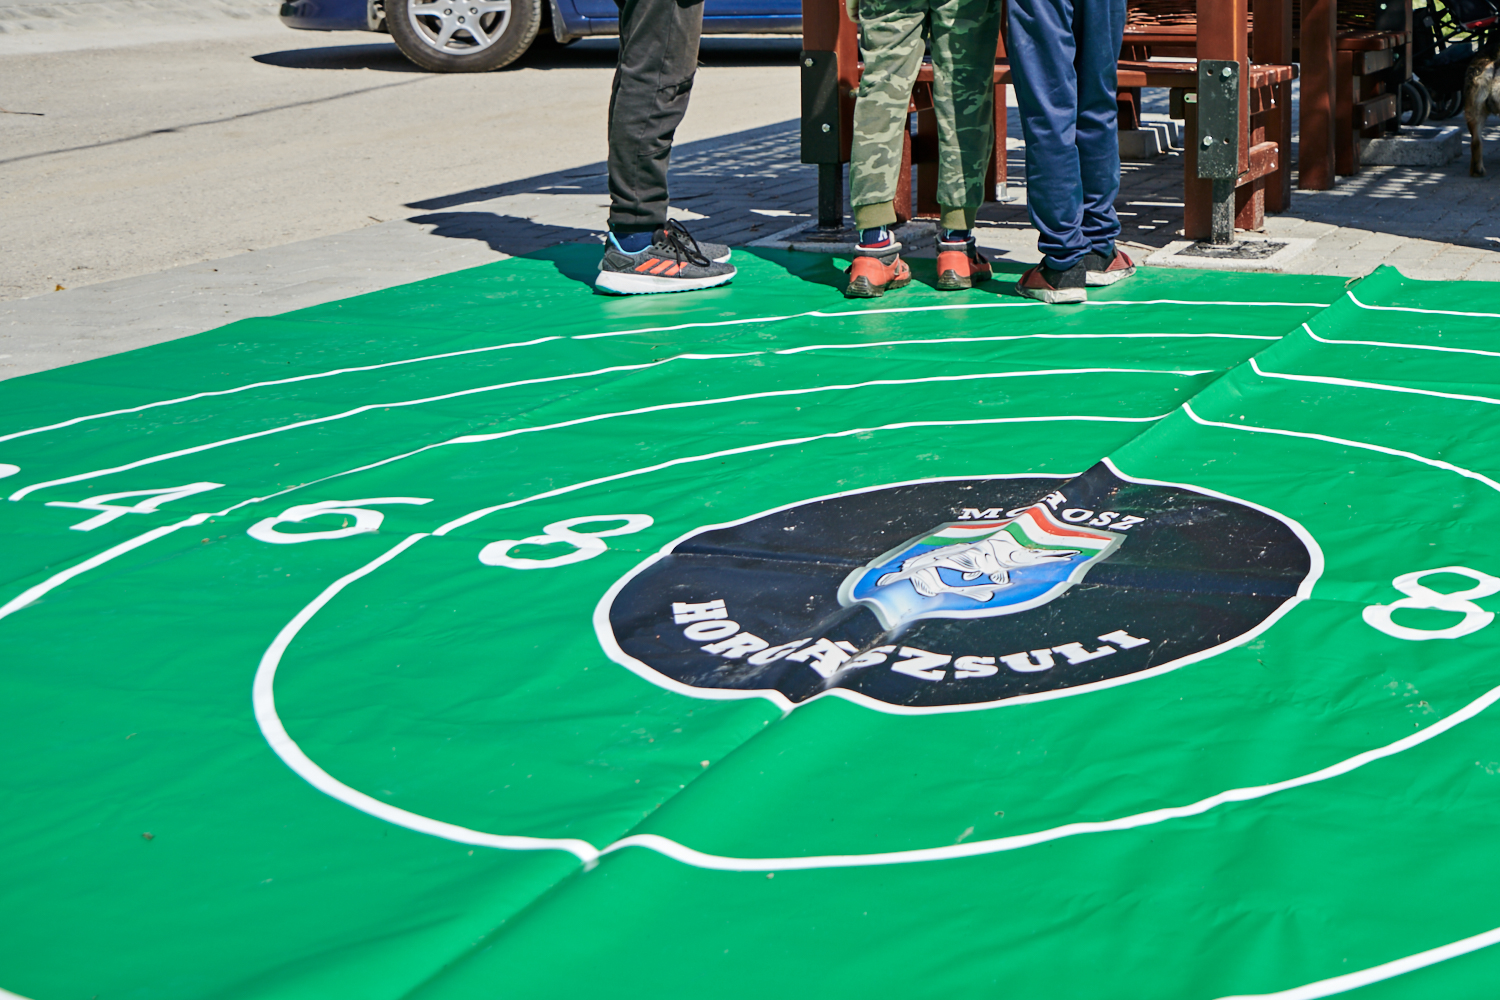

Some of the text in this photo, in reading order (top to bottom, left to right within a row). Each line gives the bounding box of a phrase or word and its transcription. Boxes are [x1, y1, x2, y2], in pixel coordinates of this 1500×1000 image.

[44, 482, 226, 531] 4
[247, 496, 435, 544] 6
[478, 514, 655, 570] 8
